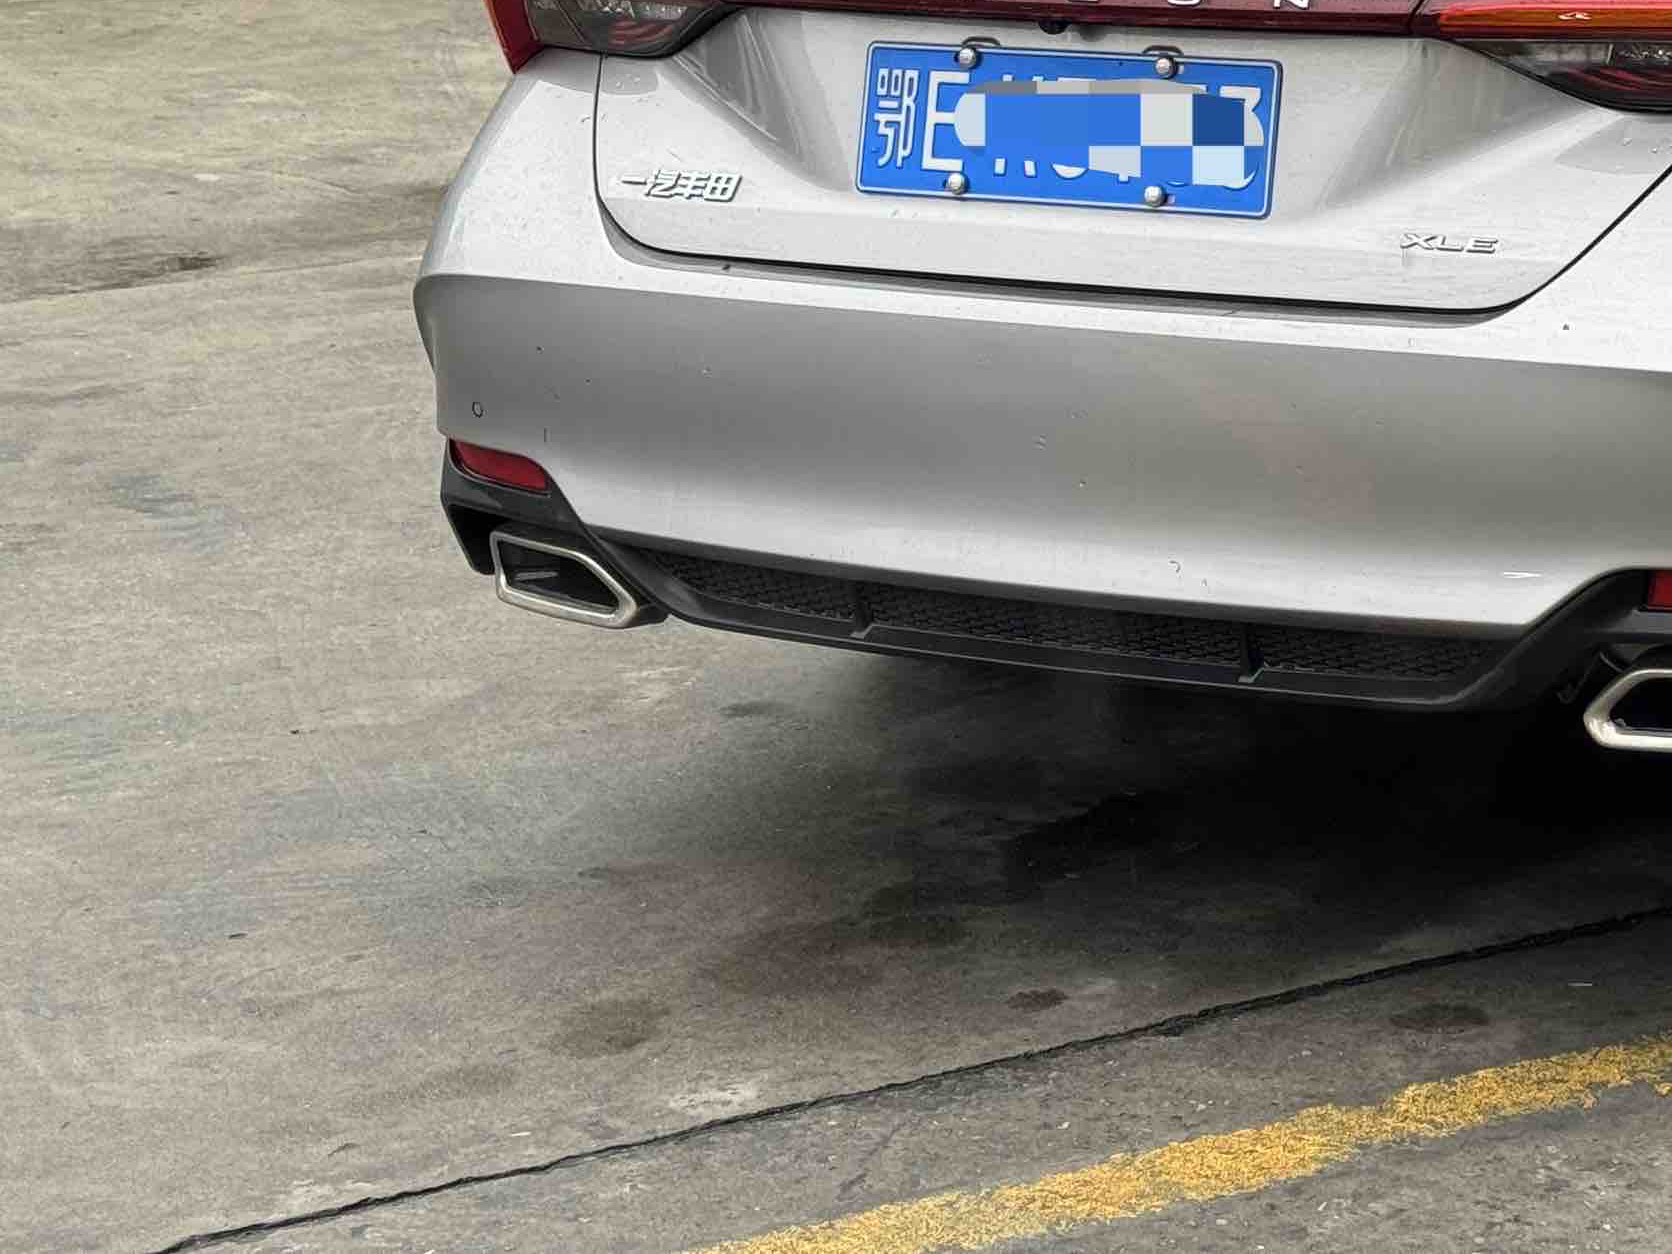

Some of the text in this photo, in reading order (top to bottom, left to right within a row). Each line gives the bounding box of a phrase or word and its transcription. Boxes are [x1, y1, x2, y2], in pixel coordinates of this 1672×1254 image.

[617, 168, 744, 203] 一汽丰田
[1399, 232, 1499, 254] XLE
